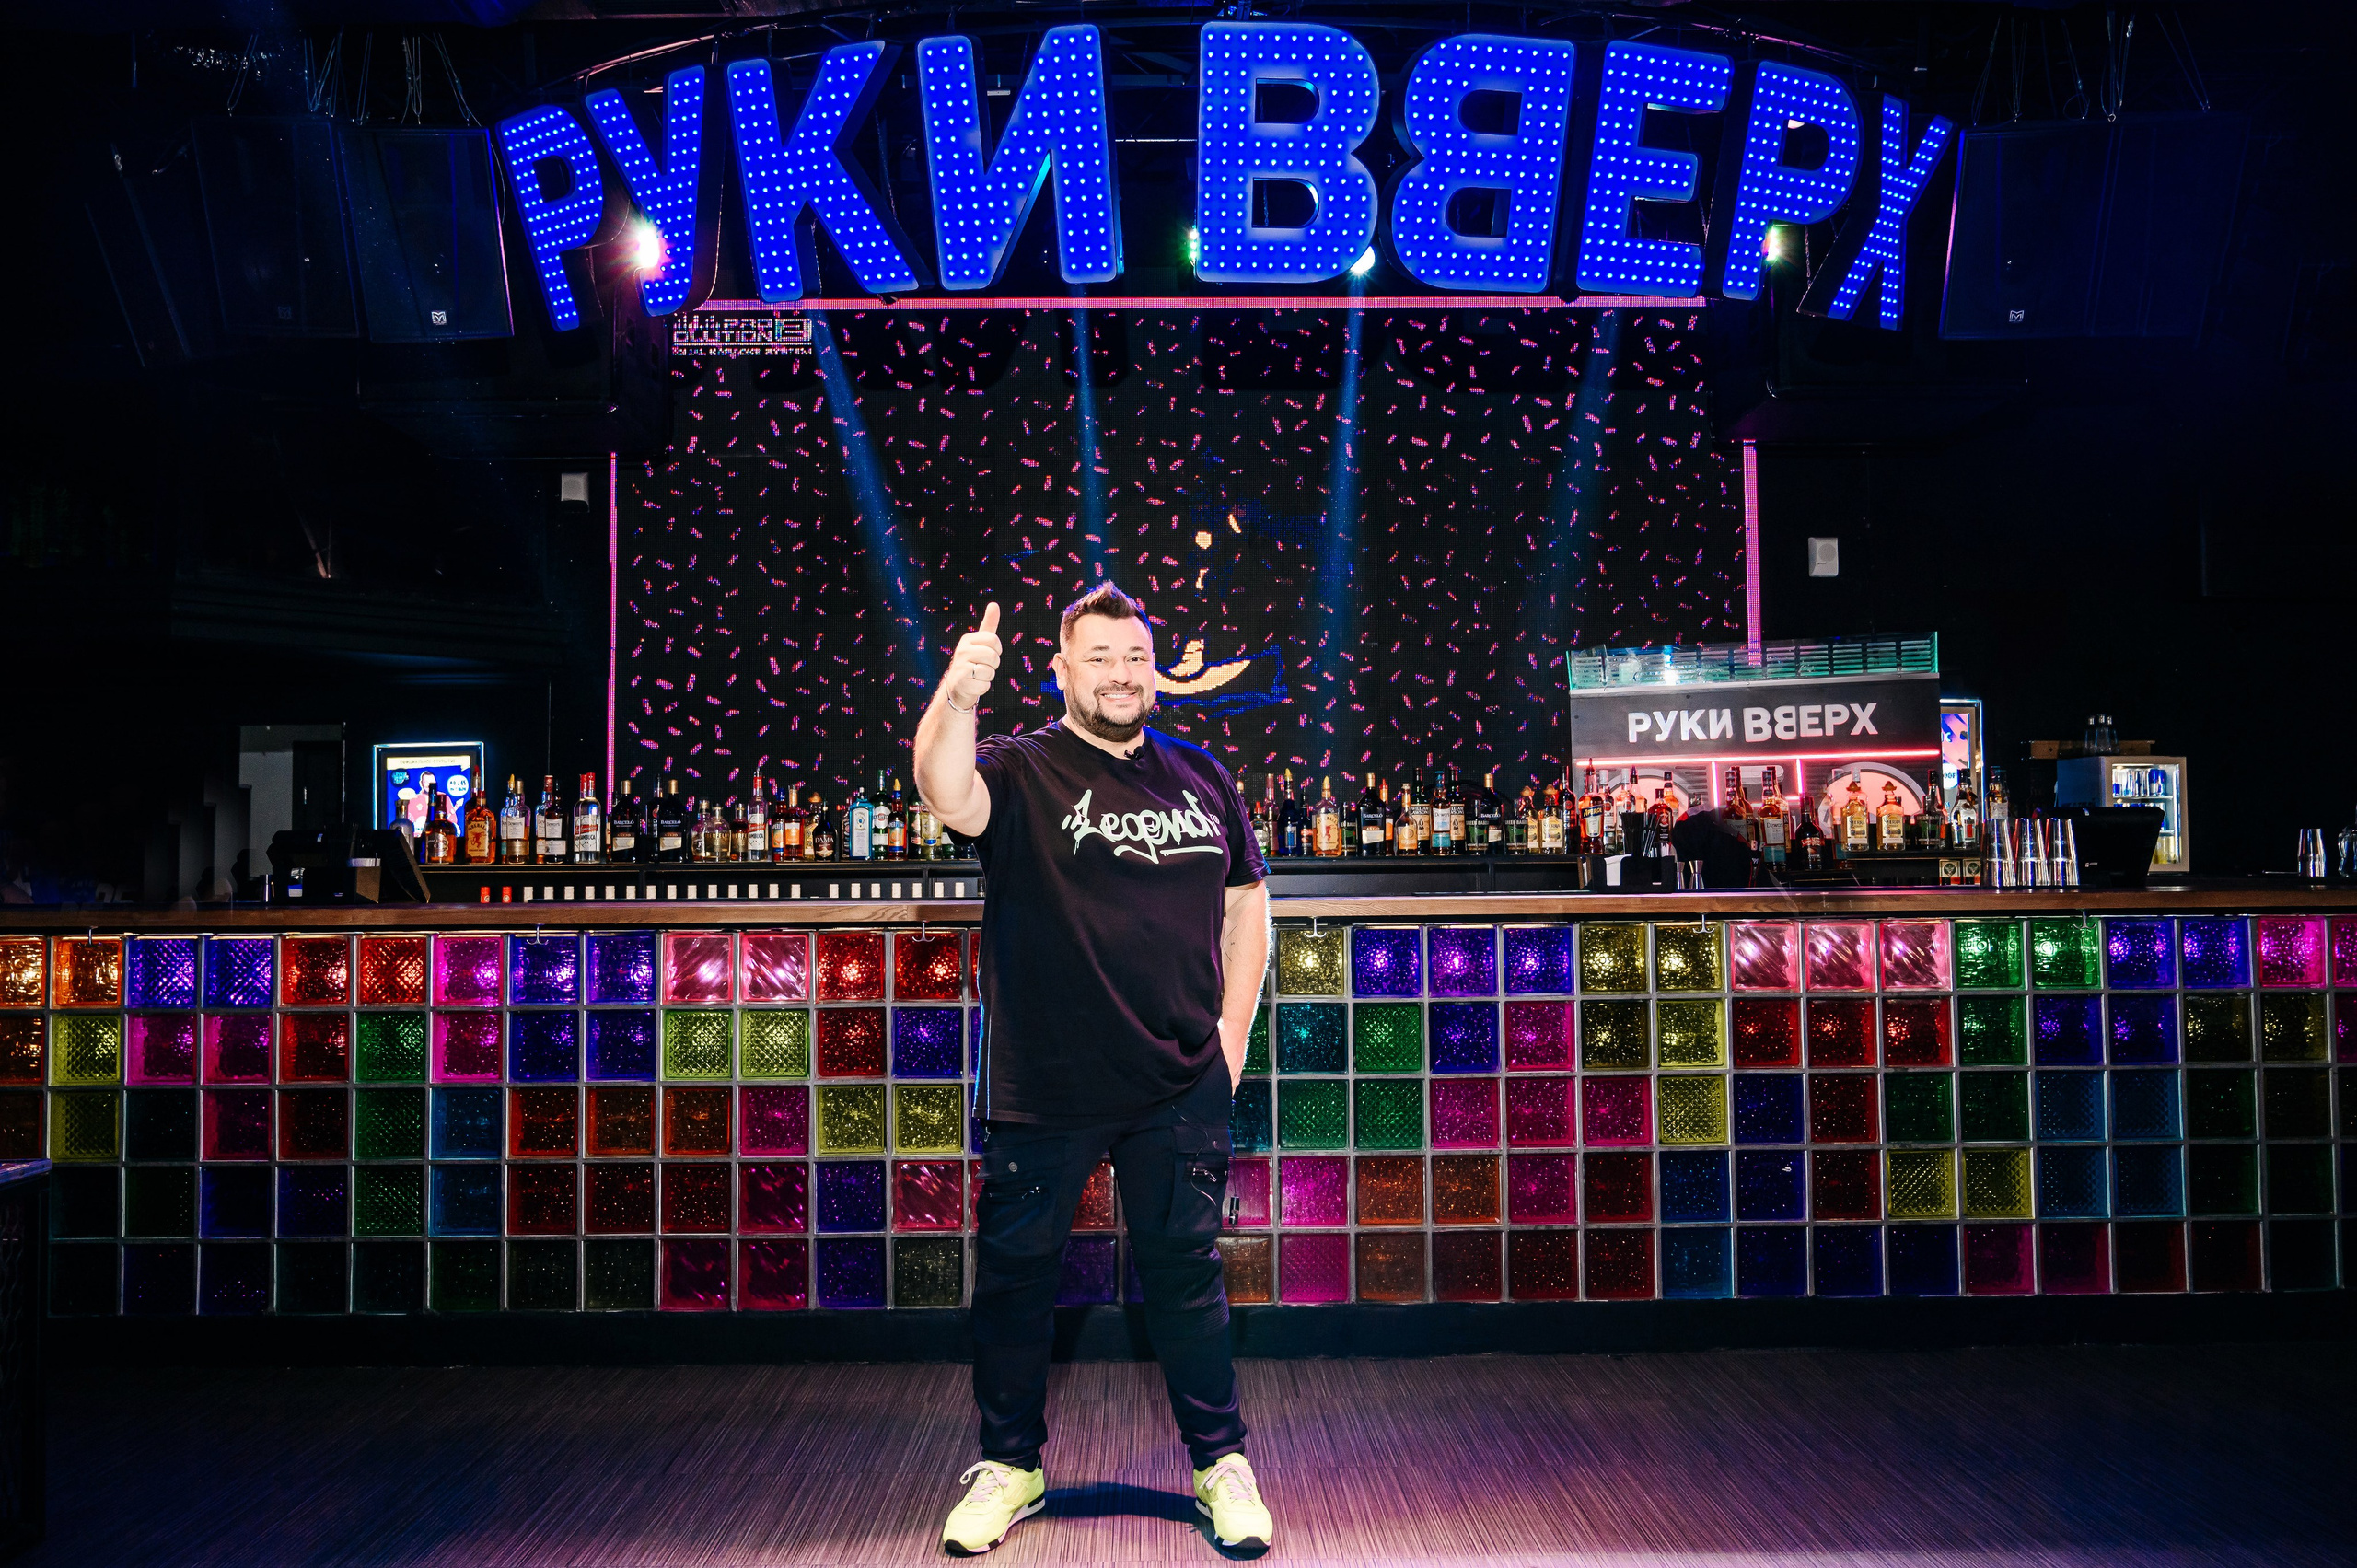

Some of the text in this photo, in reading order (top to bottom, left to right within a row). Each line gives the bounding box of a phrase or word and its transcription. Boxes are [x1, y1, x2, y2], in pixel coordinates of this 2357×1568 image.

[497, 20, 1953, 332] РУКИ ВВЕРХ
[1628, 703, 1879, 744] РУКИ ВВЕРХ
[1583, 807, 1603, 818] APEROL
